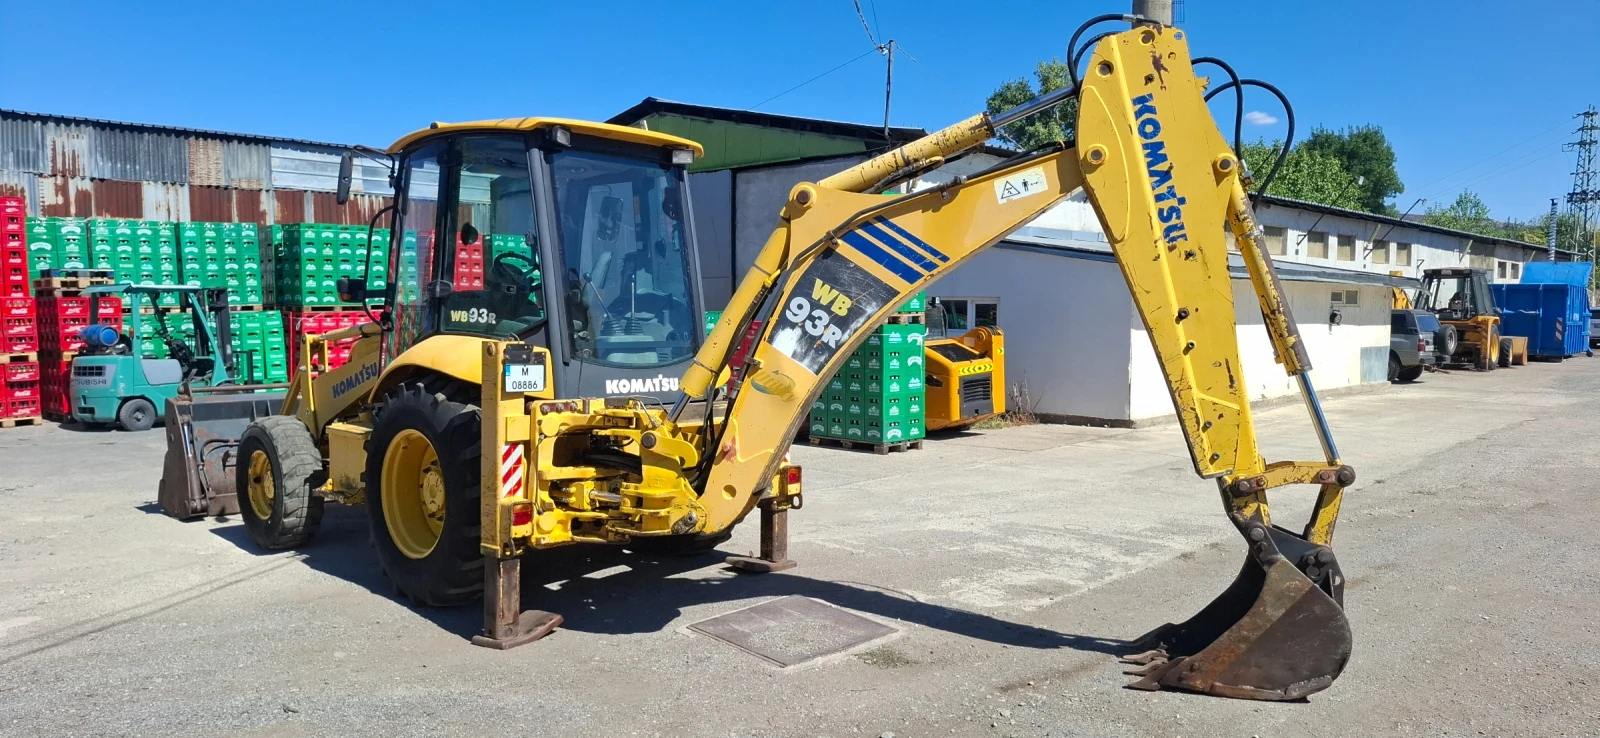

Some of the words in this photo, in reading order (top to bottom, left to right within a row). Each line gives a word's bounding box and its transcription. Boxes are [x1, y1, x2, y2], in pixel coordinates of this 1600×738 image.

[1131, 93, 1188, 246] KOMATSU
[811, 278, 852, 317] WB
[785, 296, 843, 350] 93R
[71, 378, 107, 386] TSUBISHI
[331, 362, 378, 398] KOMATSU
[511, 380, 538, 390] 08886
[521, 367, 529, 376] M
[605, 373, 680, 394] KOMATSU
